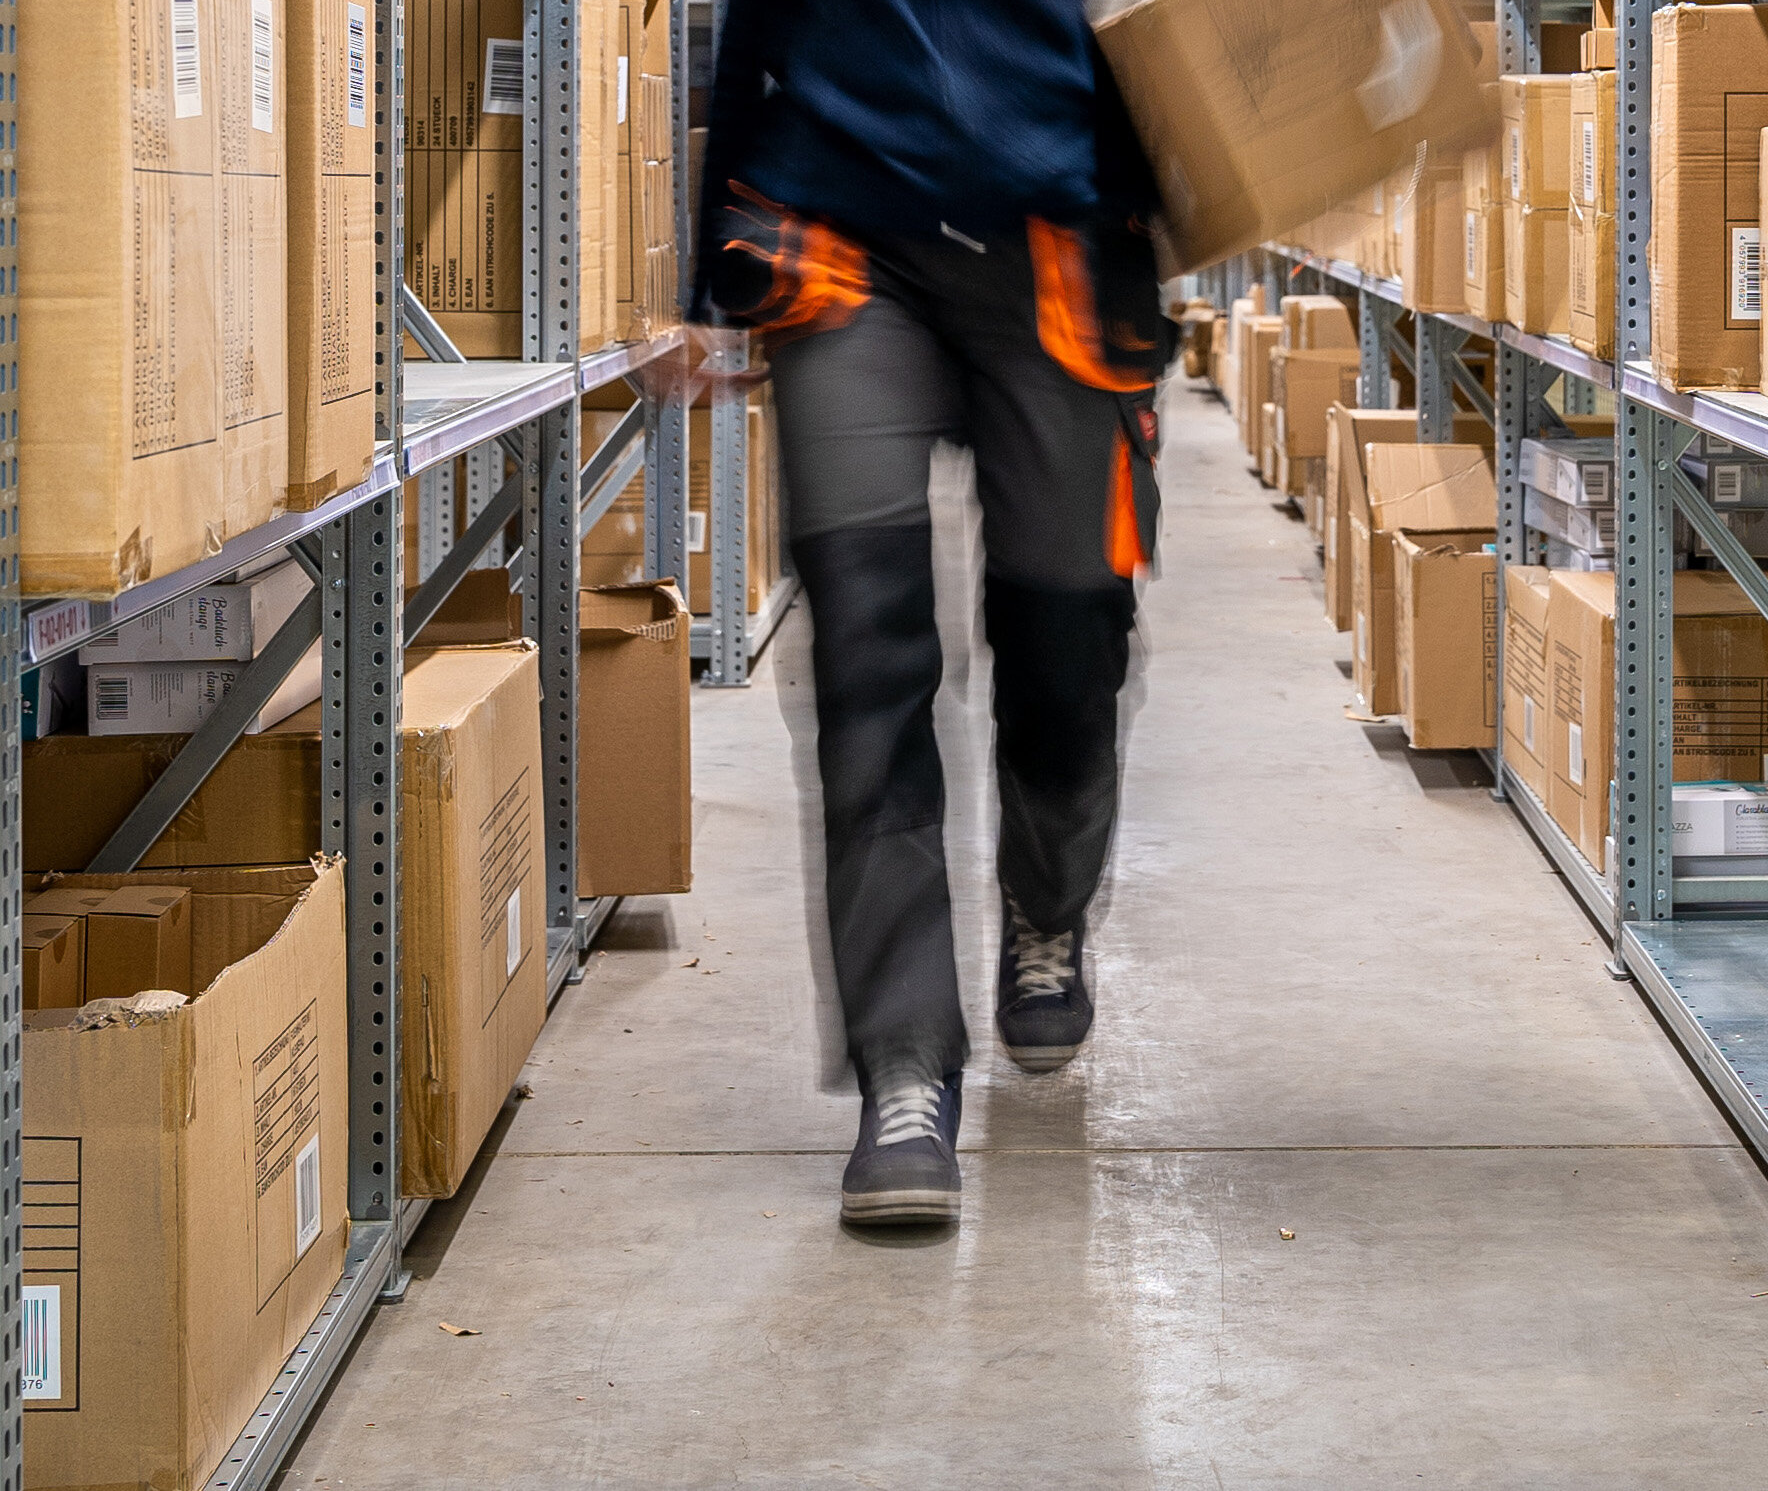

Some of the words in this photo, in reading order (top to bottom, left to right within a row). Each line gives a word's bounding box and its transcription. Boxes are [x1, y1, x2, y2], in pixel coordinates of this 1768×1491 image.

[432, 96, 442, 134] STUECK
[485, 219, 495, 276] STRICHCODE
[431, 264, 441, 297] INHALT
[448, 258, 458, 298] CHARGE
[465, 277, 474, 298] EAN
[485, 278, 495, 298] EAN
[1672, 679, 1759, 689] RTIKELBEZEICHNUNG
[1672, 702, 1718, 711] RTIKEL-NR.
[1672, 724, 1702, 733] HARGE
